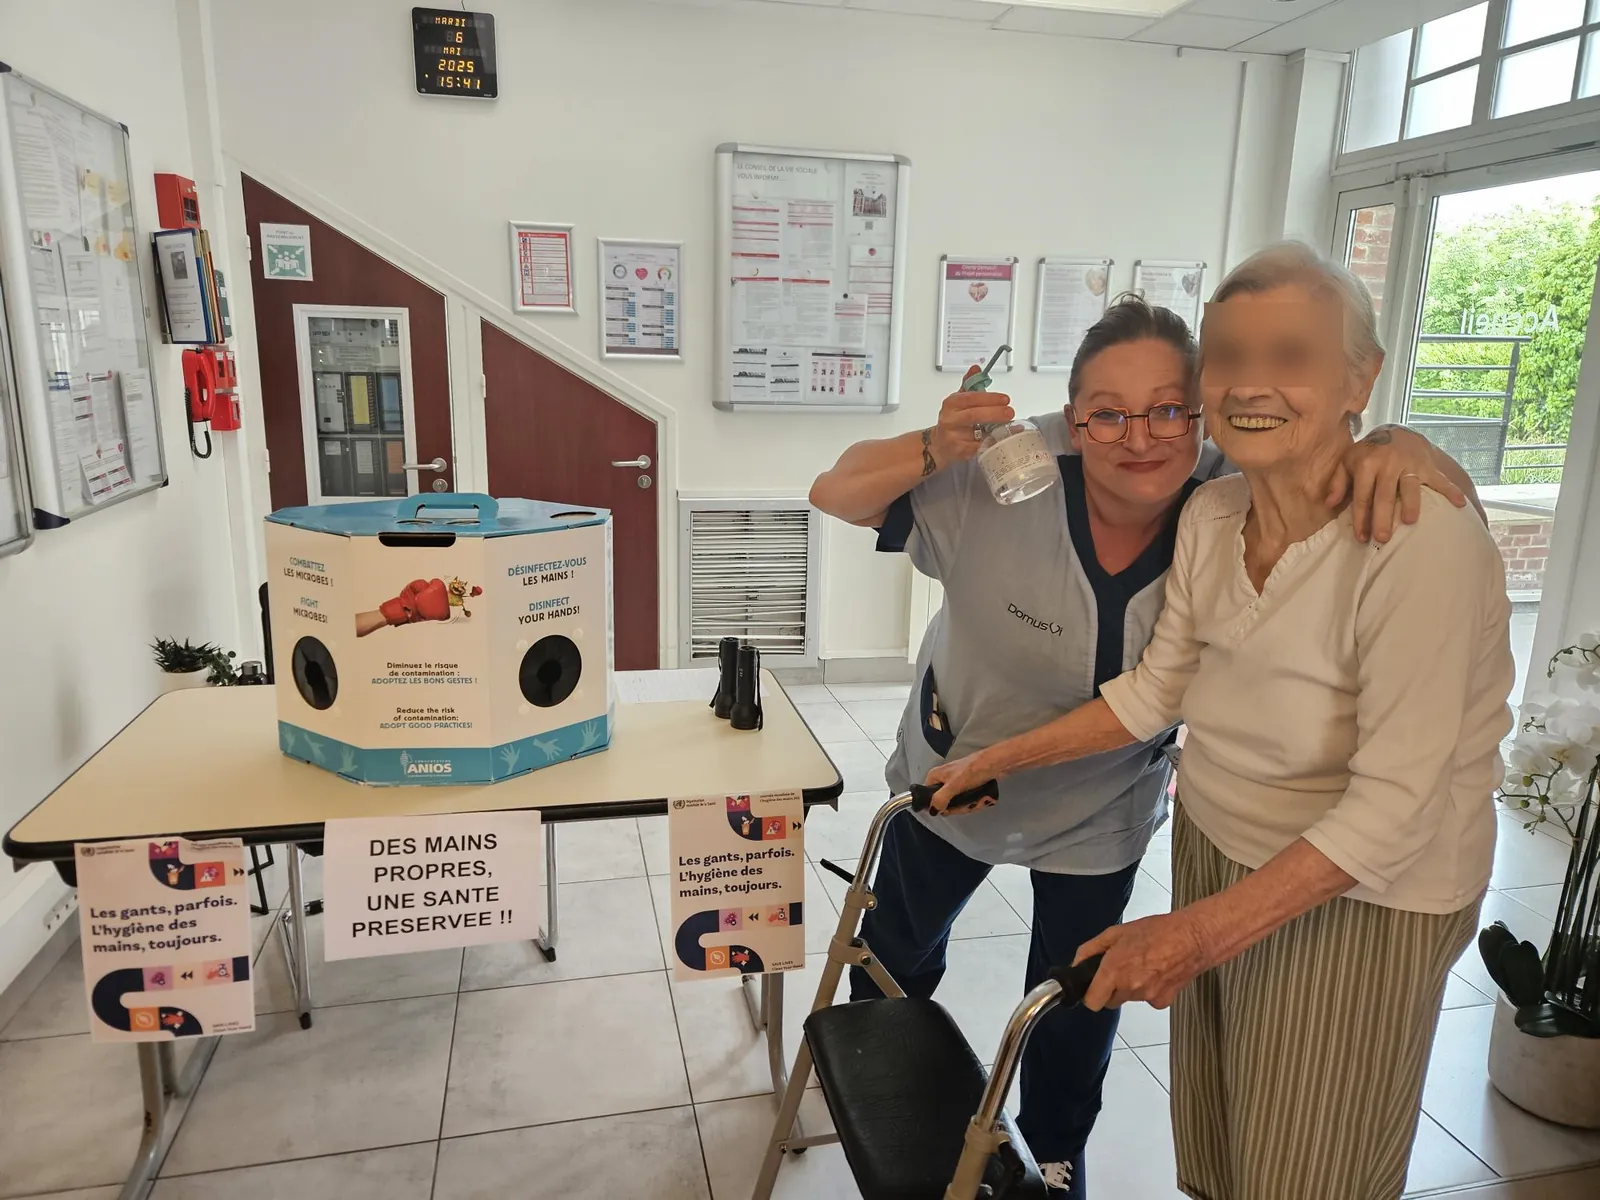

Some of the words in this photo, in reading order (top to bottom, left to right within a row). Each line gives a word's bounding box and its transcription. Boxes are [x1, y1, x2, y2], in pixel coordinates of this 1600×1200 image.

[435, 17, 466, 27] MARDI
[455, 31, 463, 43] 6
[443, 47, 460, 55] MAI
[438, 59, 474, 72] 2025
[440, 76, 480, 89] 15:41
[289, 556, 326, 572] COMBATTEZ
[507, 557, 587, 576] DÉSINFECTEZ-VOUS
[284, 567, 294, 577] LES
[296, 570, 329, 586] MICROBES
[522, 576, 538, 586] LES
[541, 570, 568, 583] MAINS
[300, 596, 318, 609] FIGHT
[529, 596, 570, 611] DISINFECT
[293, 607, 328, 623] MICROBES!
[518, 613, 545, 625] YOUR
[547, 605, 580, 619] HANDS!
[387, 661, 422, 669] Diminuez
[425, 661, 432, 669] le
[434, 662, 458, 670] risque
[407, 763, 452, 774] ANIOS
[370, 837, 417, 857] DES
[425, 833, 498, 853] MAINS
[679, 855, 701, 867] Les
[703, 852, 744, 867] gants,
[746, 847, 795, 863] parfois.
[374, 860, 493, 883] PROPRES,
[740, 865, 763, 877] des
[679, 885, 722, 898] mains,
[724, 881, 782, 893] toujours.
[367, 893, 415, 911] UNE
[423, 886, 500, 907] SANTE
[90, 907, 117, 919] Les
[120, 905, 172, 921] gants,
[175, 895, 238, 916] parfois.
[168, 918, 197, 931] des
[352, 911, 492, 938] PRESERVEE
[500, 909, 513, 925] !!
[93, 940, 146, 953] mains,
[148, 932, 222, 950] toujours.
